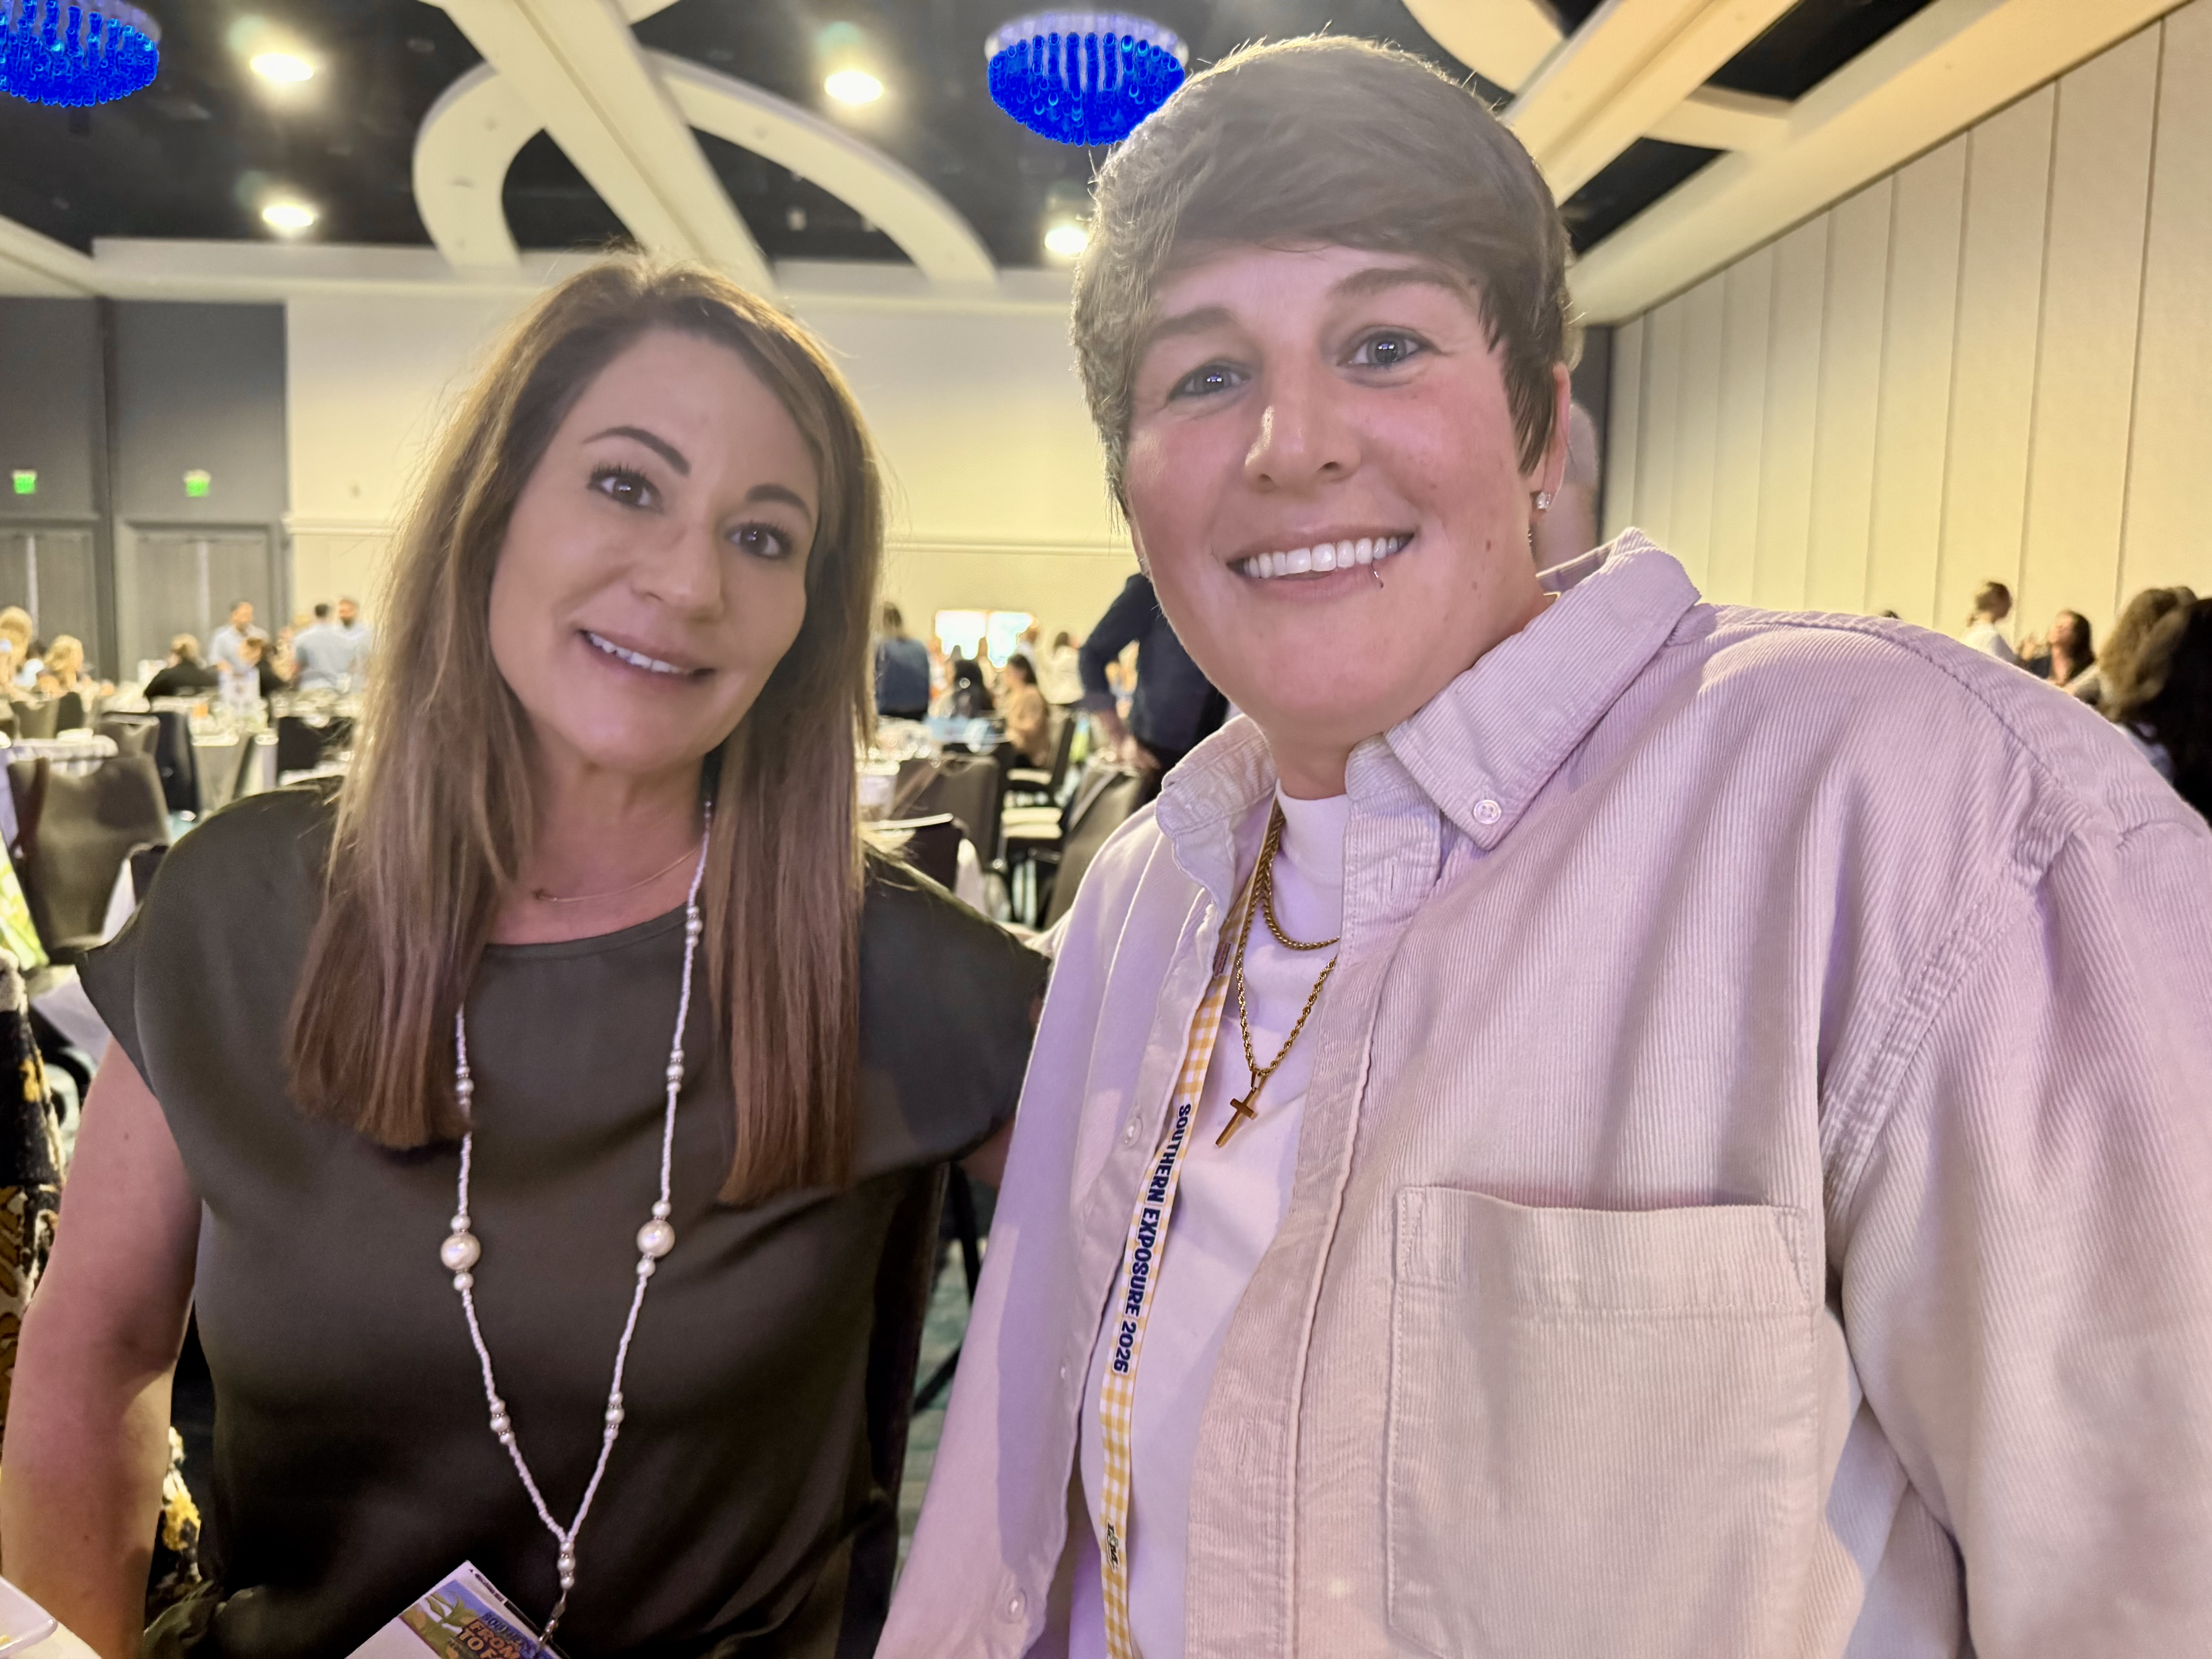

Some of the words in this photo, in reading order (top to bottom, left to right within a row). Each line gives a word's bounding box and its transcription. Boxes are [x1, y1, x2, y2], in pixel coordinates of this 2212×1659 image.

[1147, 1103, 1191, 1203] SOUTHERN
[1124, 1207, 1161, 1317] EXPOSURE
[1113, 1320, 1137, 1373] 2026
[460, 1628, 484, 1650] TO
[469, 1620, 520, 1659] FROM
